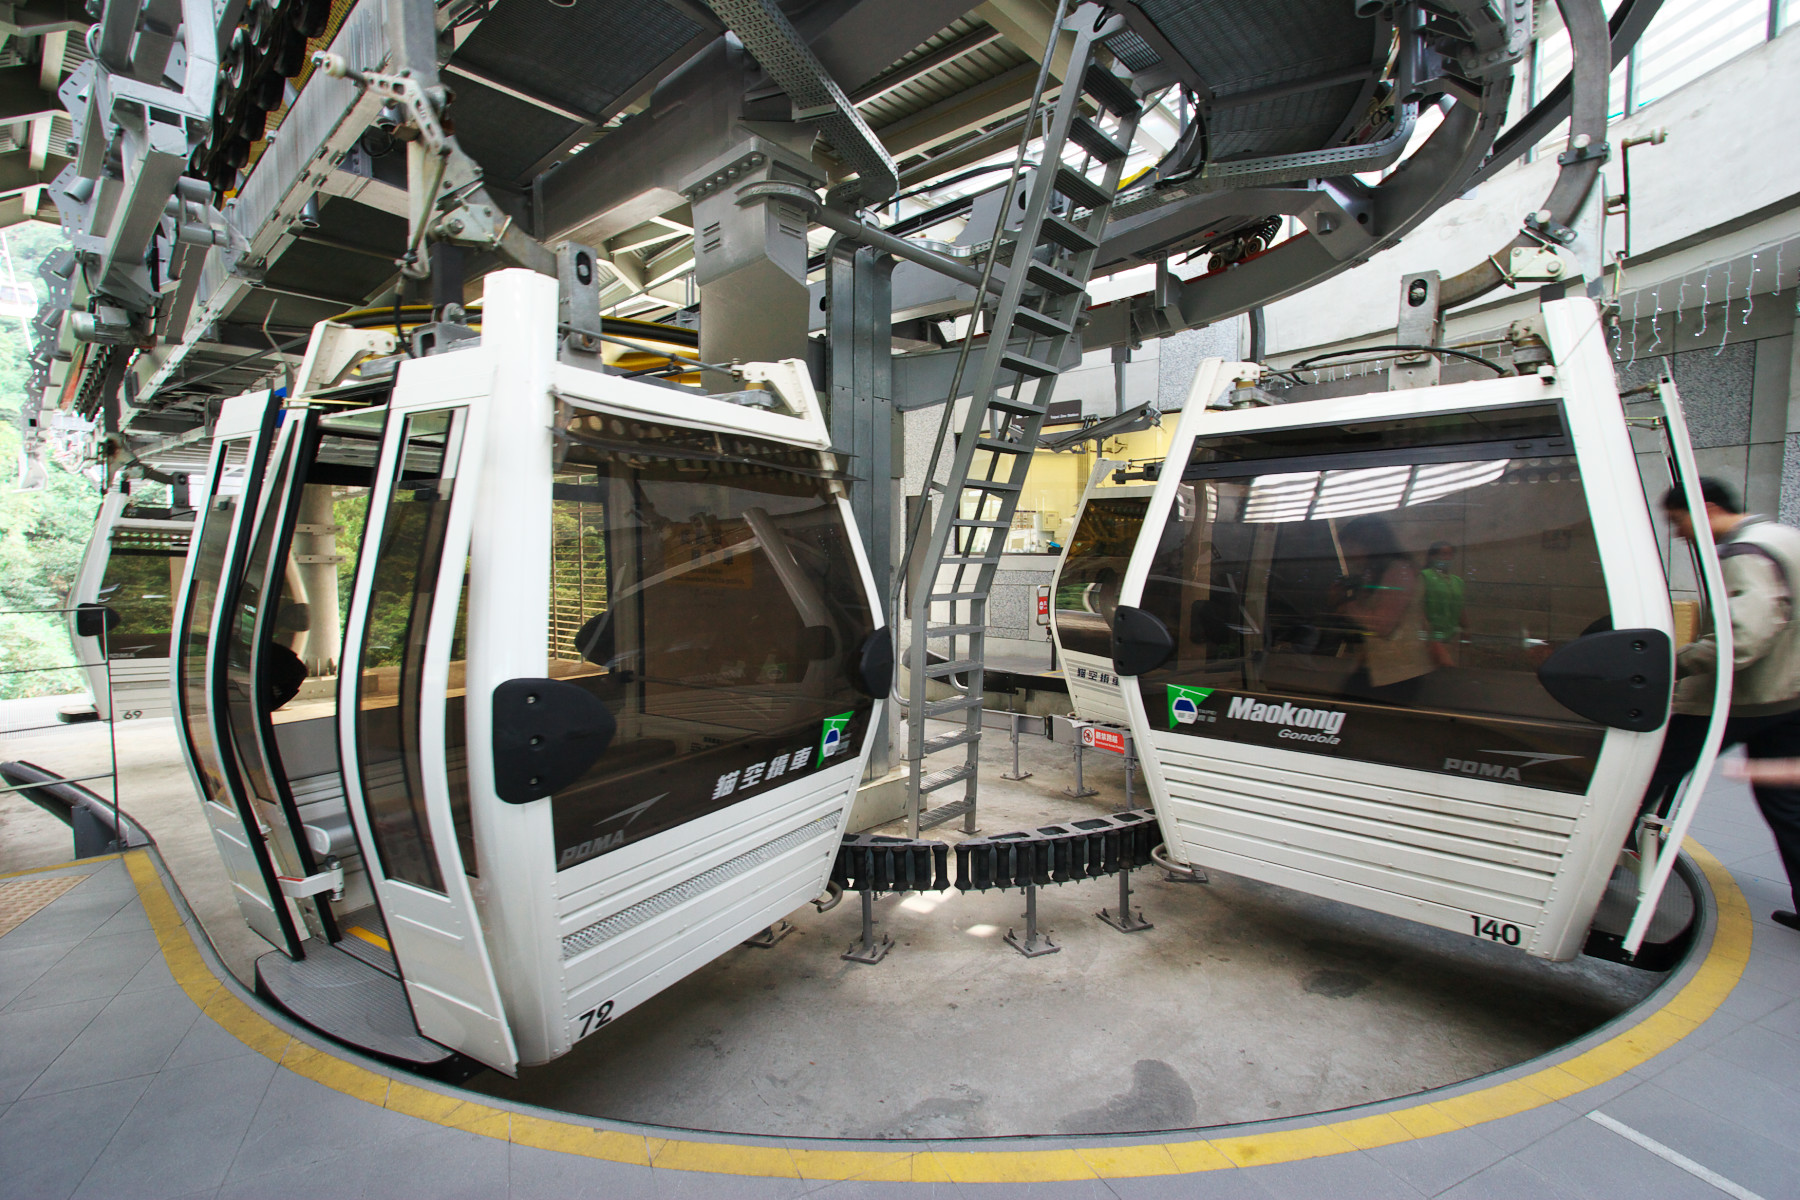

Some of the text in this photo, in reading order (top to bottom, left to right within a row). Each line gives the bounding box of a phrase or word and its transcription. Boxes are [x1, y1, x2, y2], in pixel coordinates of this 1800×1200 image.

[123, 710, 143, 720] 69
[1227, 696, 1347, 735] Maokong
[1278, 728, 1342, 745] Gondola
[1443, 757, 1522, 781] POMA
[560, 829, 624, 865] POMA
[1471, 915, 1521, 946] 140
[579, 999, 614, 1038] 72
